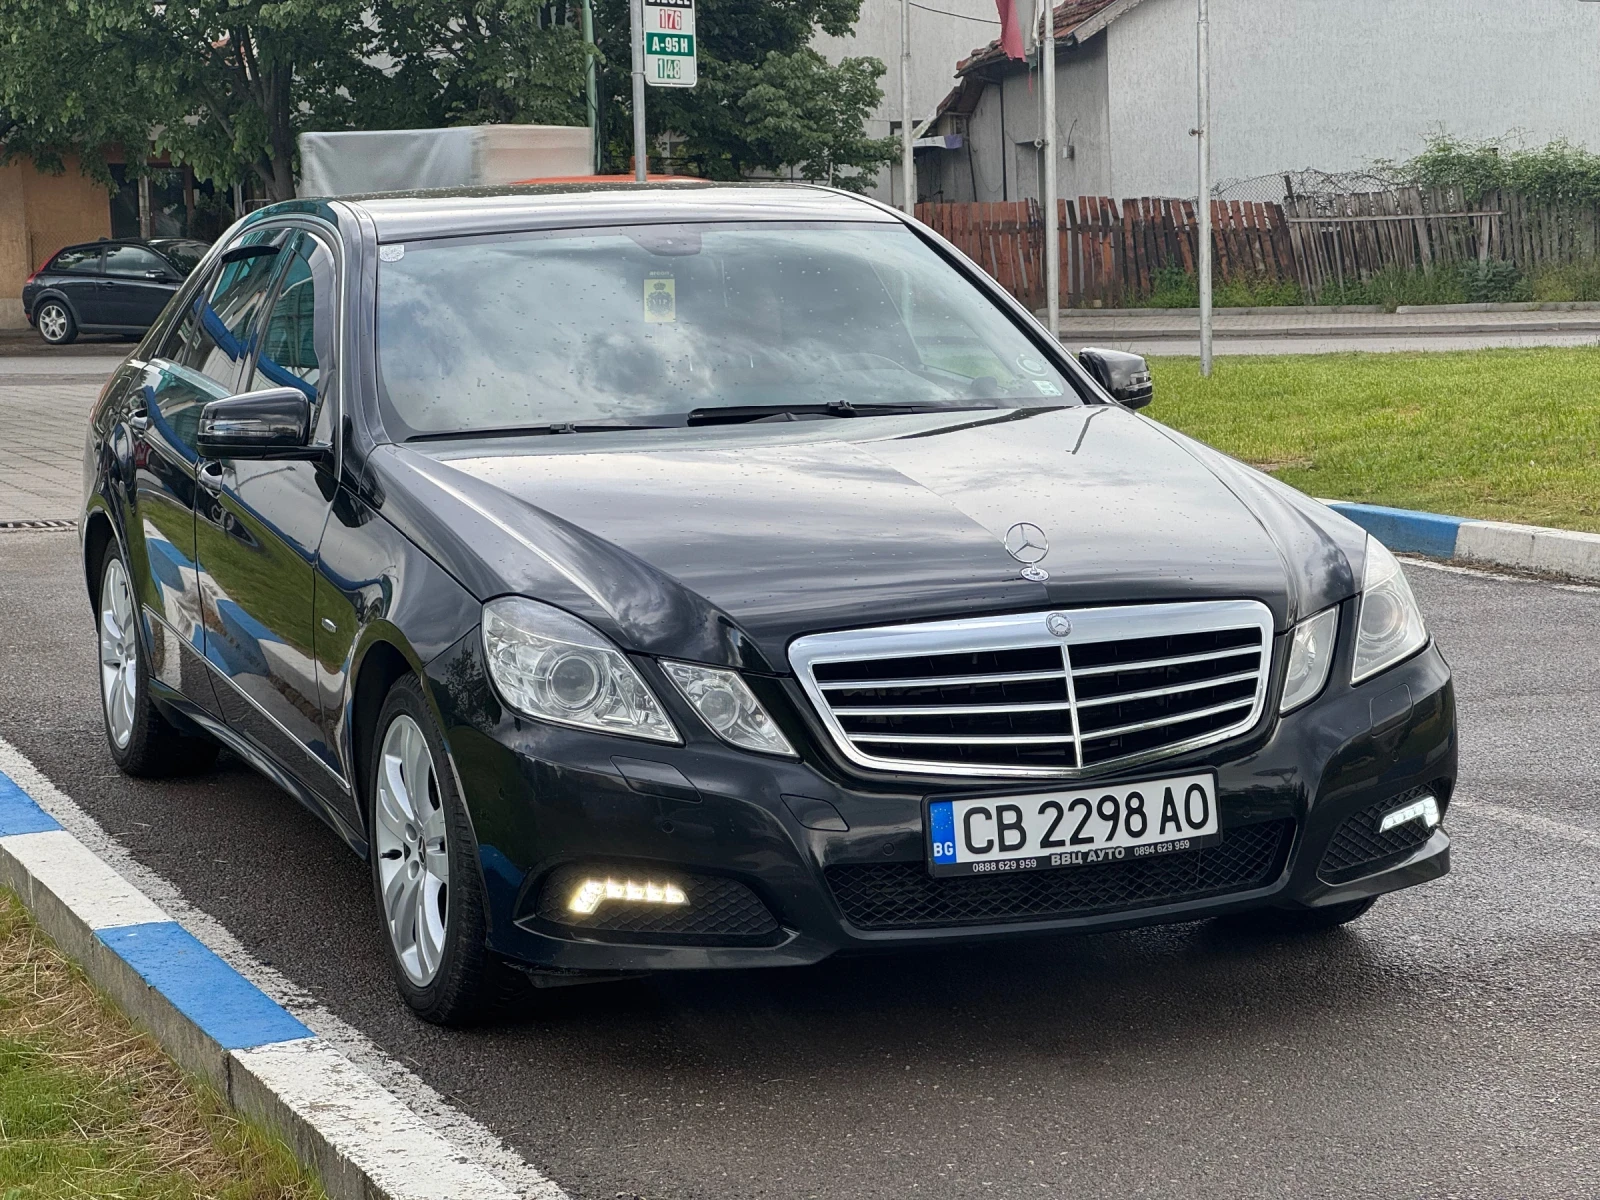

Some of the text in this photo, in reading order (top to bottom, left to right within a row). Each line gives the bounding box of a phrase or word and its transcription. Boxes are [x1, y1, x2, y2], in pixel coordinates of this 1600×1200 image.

[660, 9, 681, 30] 176
[658, 58, 680, 79] 148
[963, 783, 1210, 855] CB 2298 AO
[933, 841, 954, 857] BG
[1134, 839, 1190, 857] 0894 629 959
[972, 859, 1037, 872] 0888 629 959
